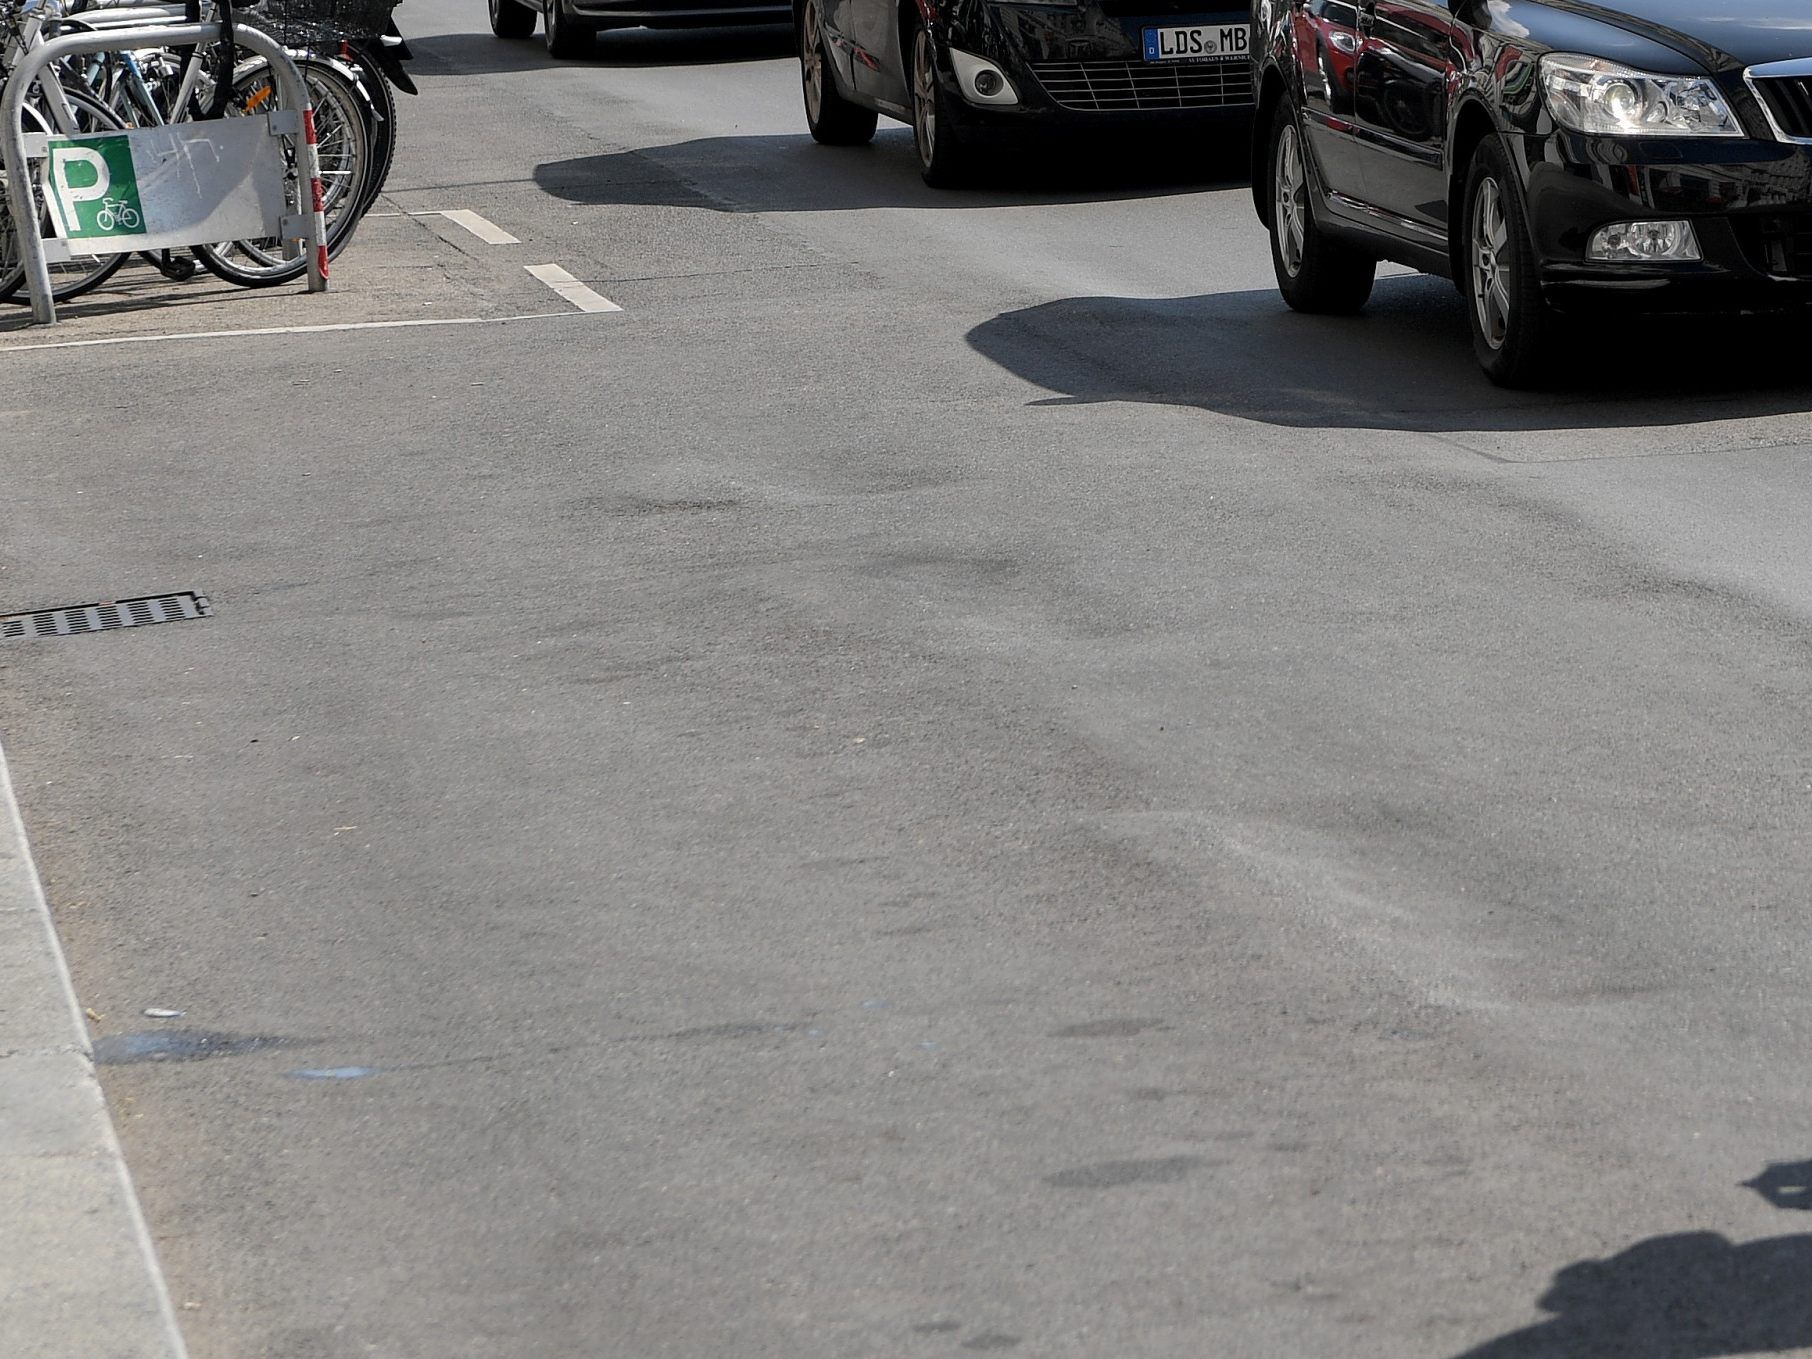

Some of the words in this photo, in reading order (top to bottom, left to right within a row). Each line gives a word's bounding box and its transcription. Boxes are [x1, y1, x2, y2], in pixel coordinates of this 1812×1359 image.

[1160, 30, 1203, 55] LDS
[1220, 27, 1248, 52] MB
[52, 146, 111, 232] P
